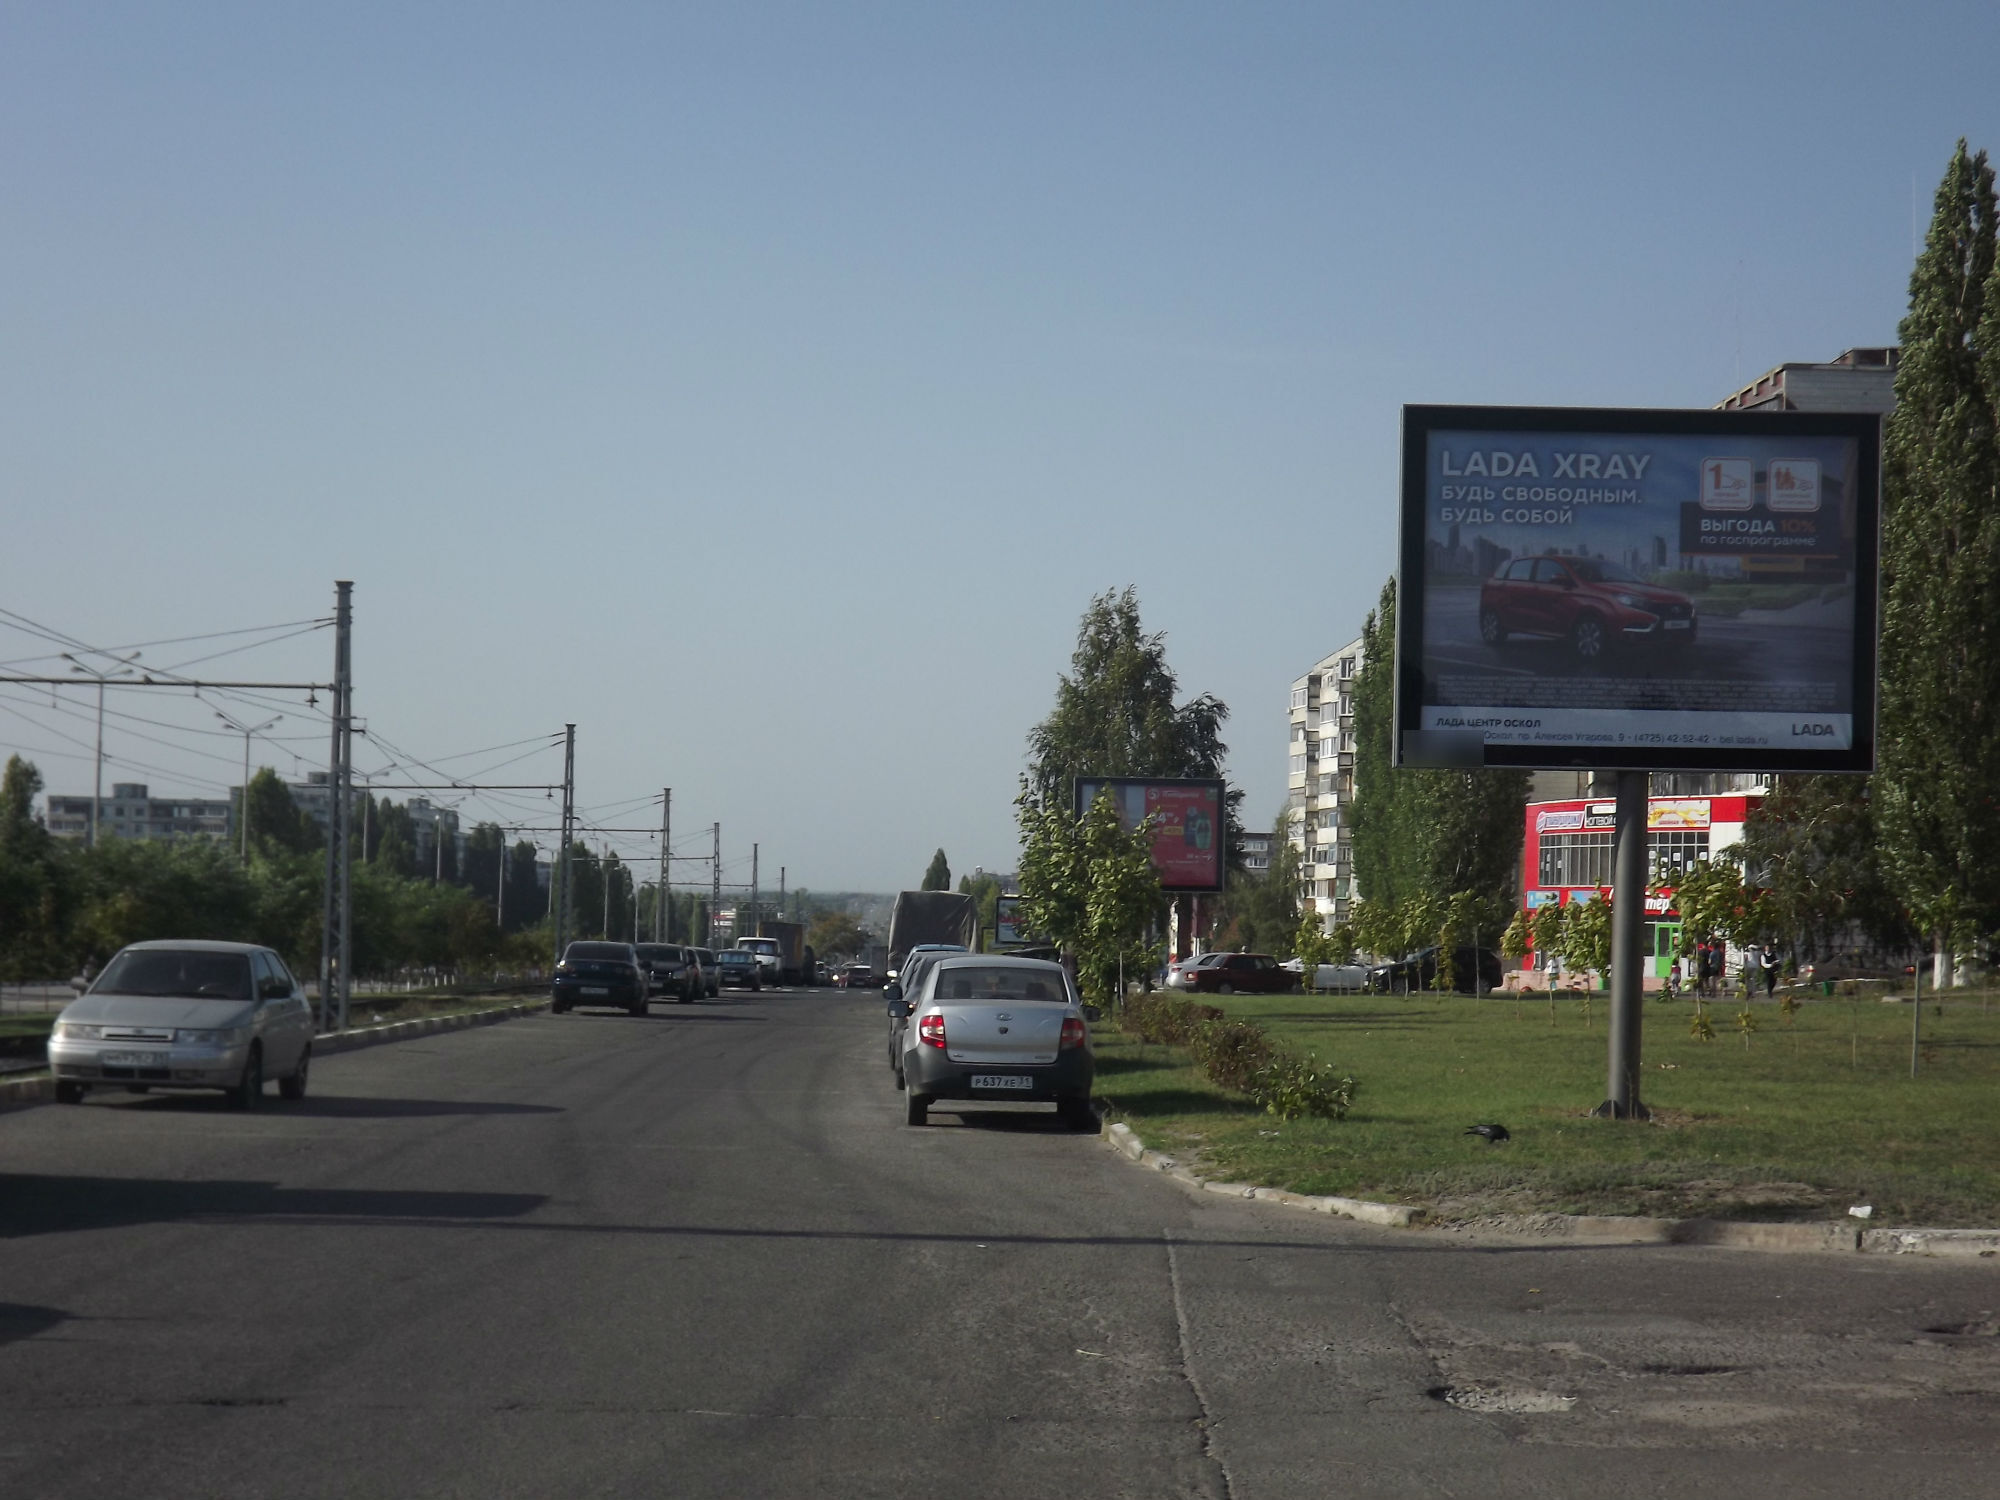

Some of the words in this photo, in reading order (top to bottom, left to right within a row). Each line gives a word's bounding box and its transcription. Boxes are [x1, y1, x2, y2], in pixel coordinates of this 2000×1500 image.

[1442, 451, 1540, 477] LADA
[1552, 453, 1650, 479] XRAY
[1441, 485, 1495, 503] БУДЬ
[1501, 486, 1643, 504] СВОБОДНЫМ.
[1441, 508, 1495, 525] БУДЬ
[1501, 506, 1573, 524] СОБОЙ
[1701, 519, 1776, 534] ВЫГОДА
[1700, 535, 1718, 544] по
[1436, 718, 1465, 728] ЛАДА
[1467, 718, 1502, 729] ЦЕНТР
[1503, 719, 1541, 728] ОСКОЛ
[1792, 723, 1835, 737] LADA
